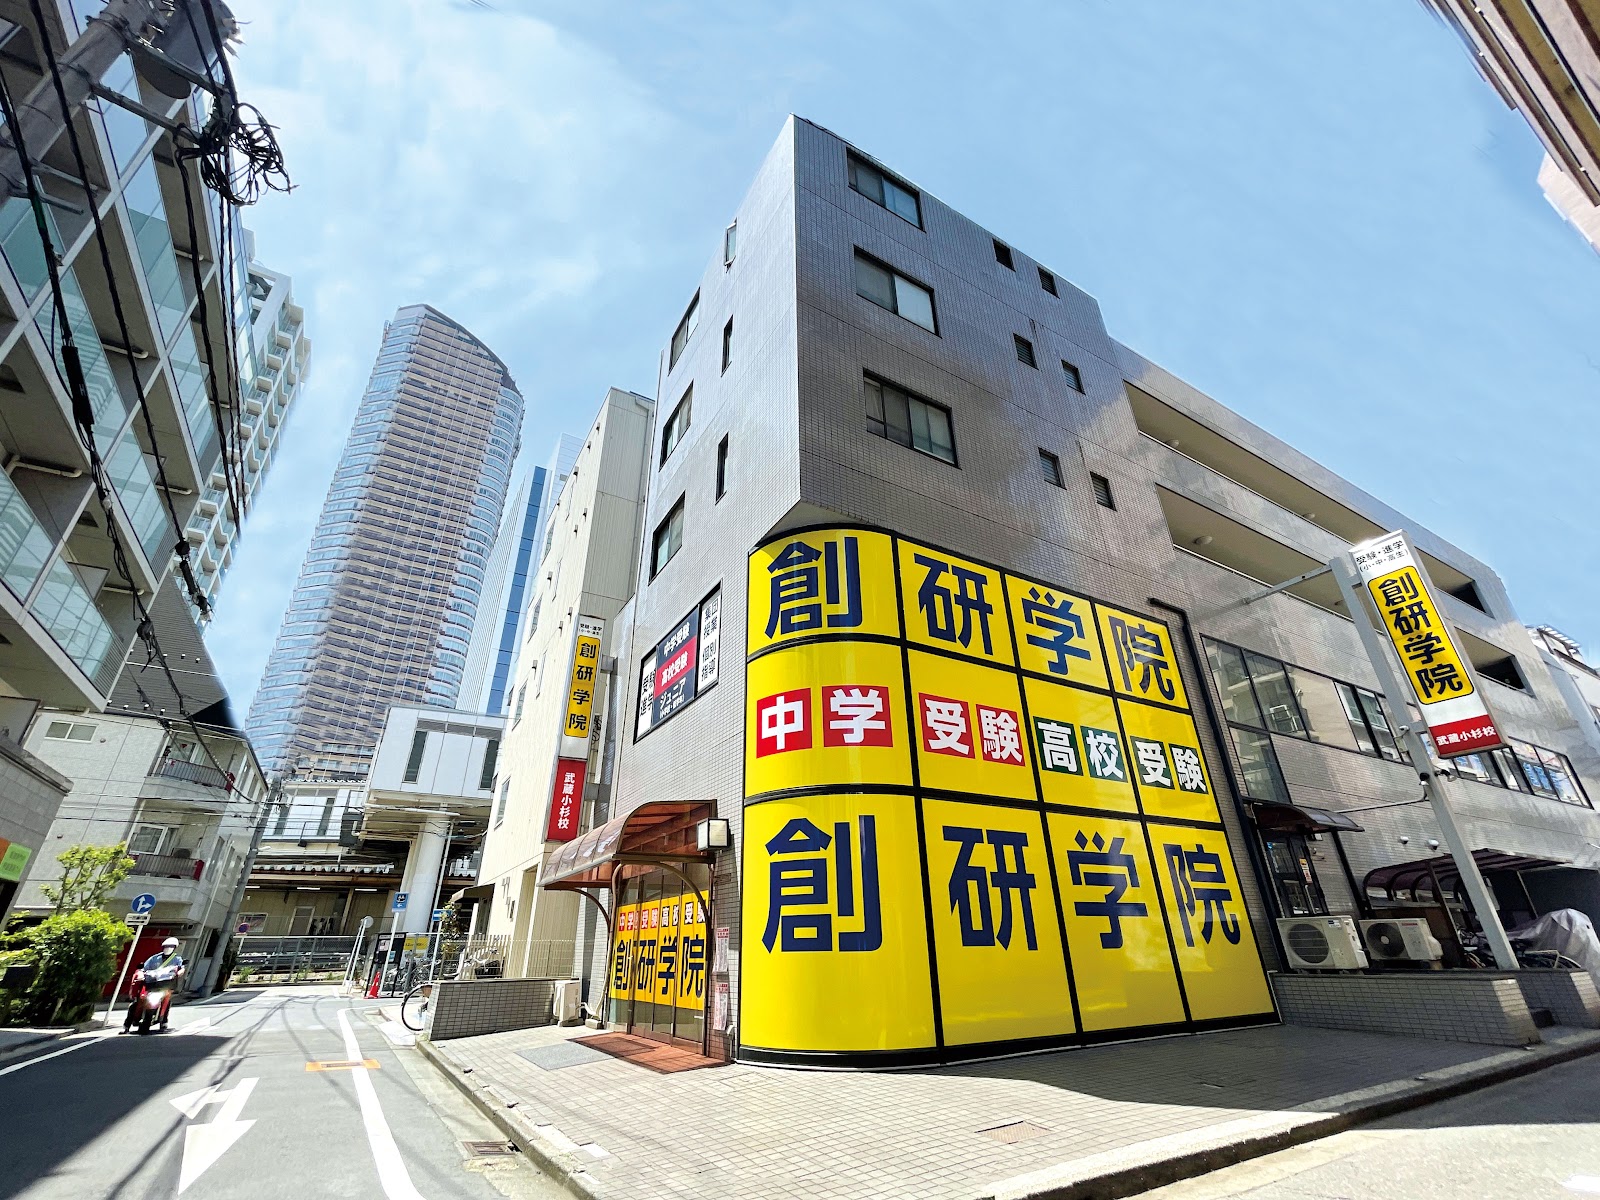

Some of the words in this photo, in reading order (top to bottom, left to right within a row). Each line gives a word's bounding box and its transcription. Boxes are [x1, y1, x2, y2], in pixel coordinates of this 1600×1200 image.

[1355, 540, 1404, 565] 受験・進学
[703, 615, 718, 640] 授業
[704, 597, 719, 622] 集団
[764, 536, 1176, 701] 創研学院
[663, 621, 690, 657] 中学受験
[702, 638, 717, 664] 個別
[1378, 571, 1463, 699] 創研学院
[568, 642, 596, 731] 創研学院
[661, 650, 689, 687] 高校受験
[660, 677, 687, 710] ジュニア
[760, 688, 1023, 763] 中学受験
[1036, 721, 1207, 793] 高校受験
[1435, 726, 1497, 746] 武蔵小杉校
[558, 773, 575, 829] 武蔵小杉校
[761, 813, 1242, 954] 創研学院
[615, 934, 704, 998] 創研学院
